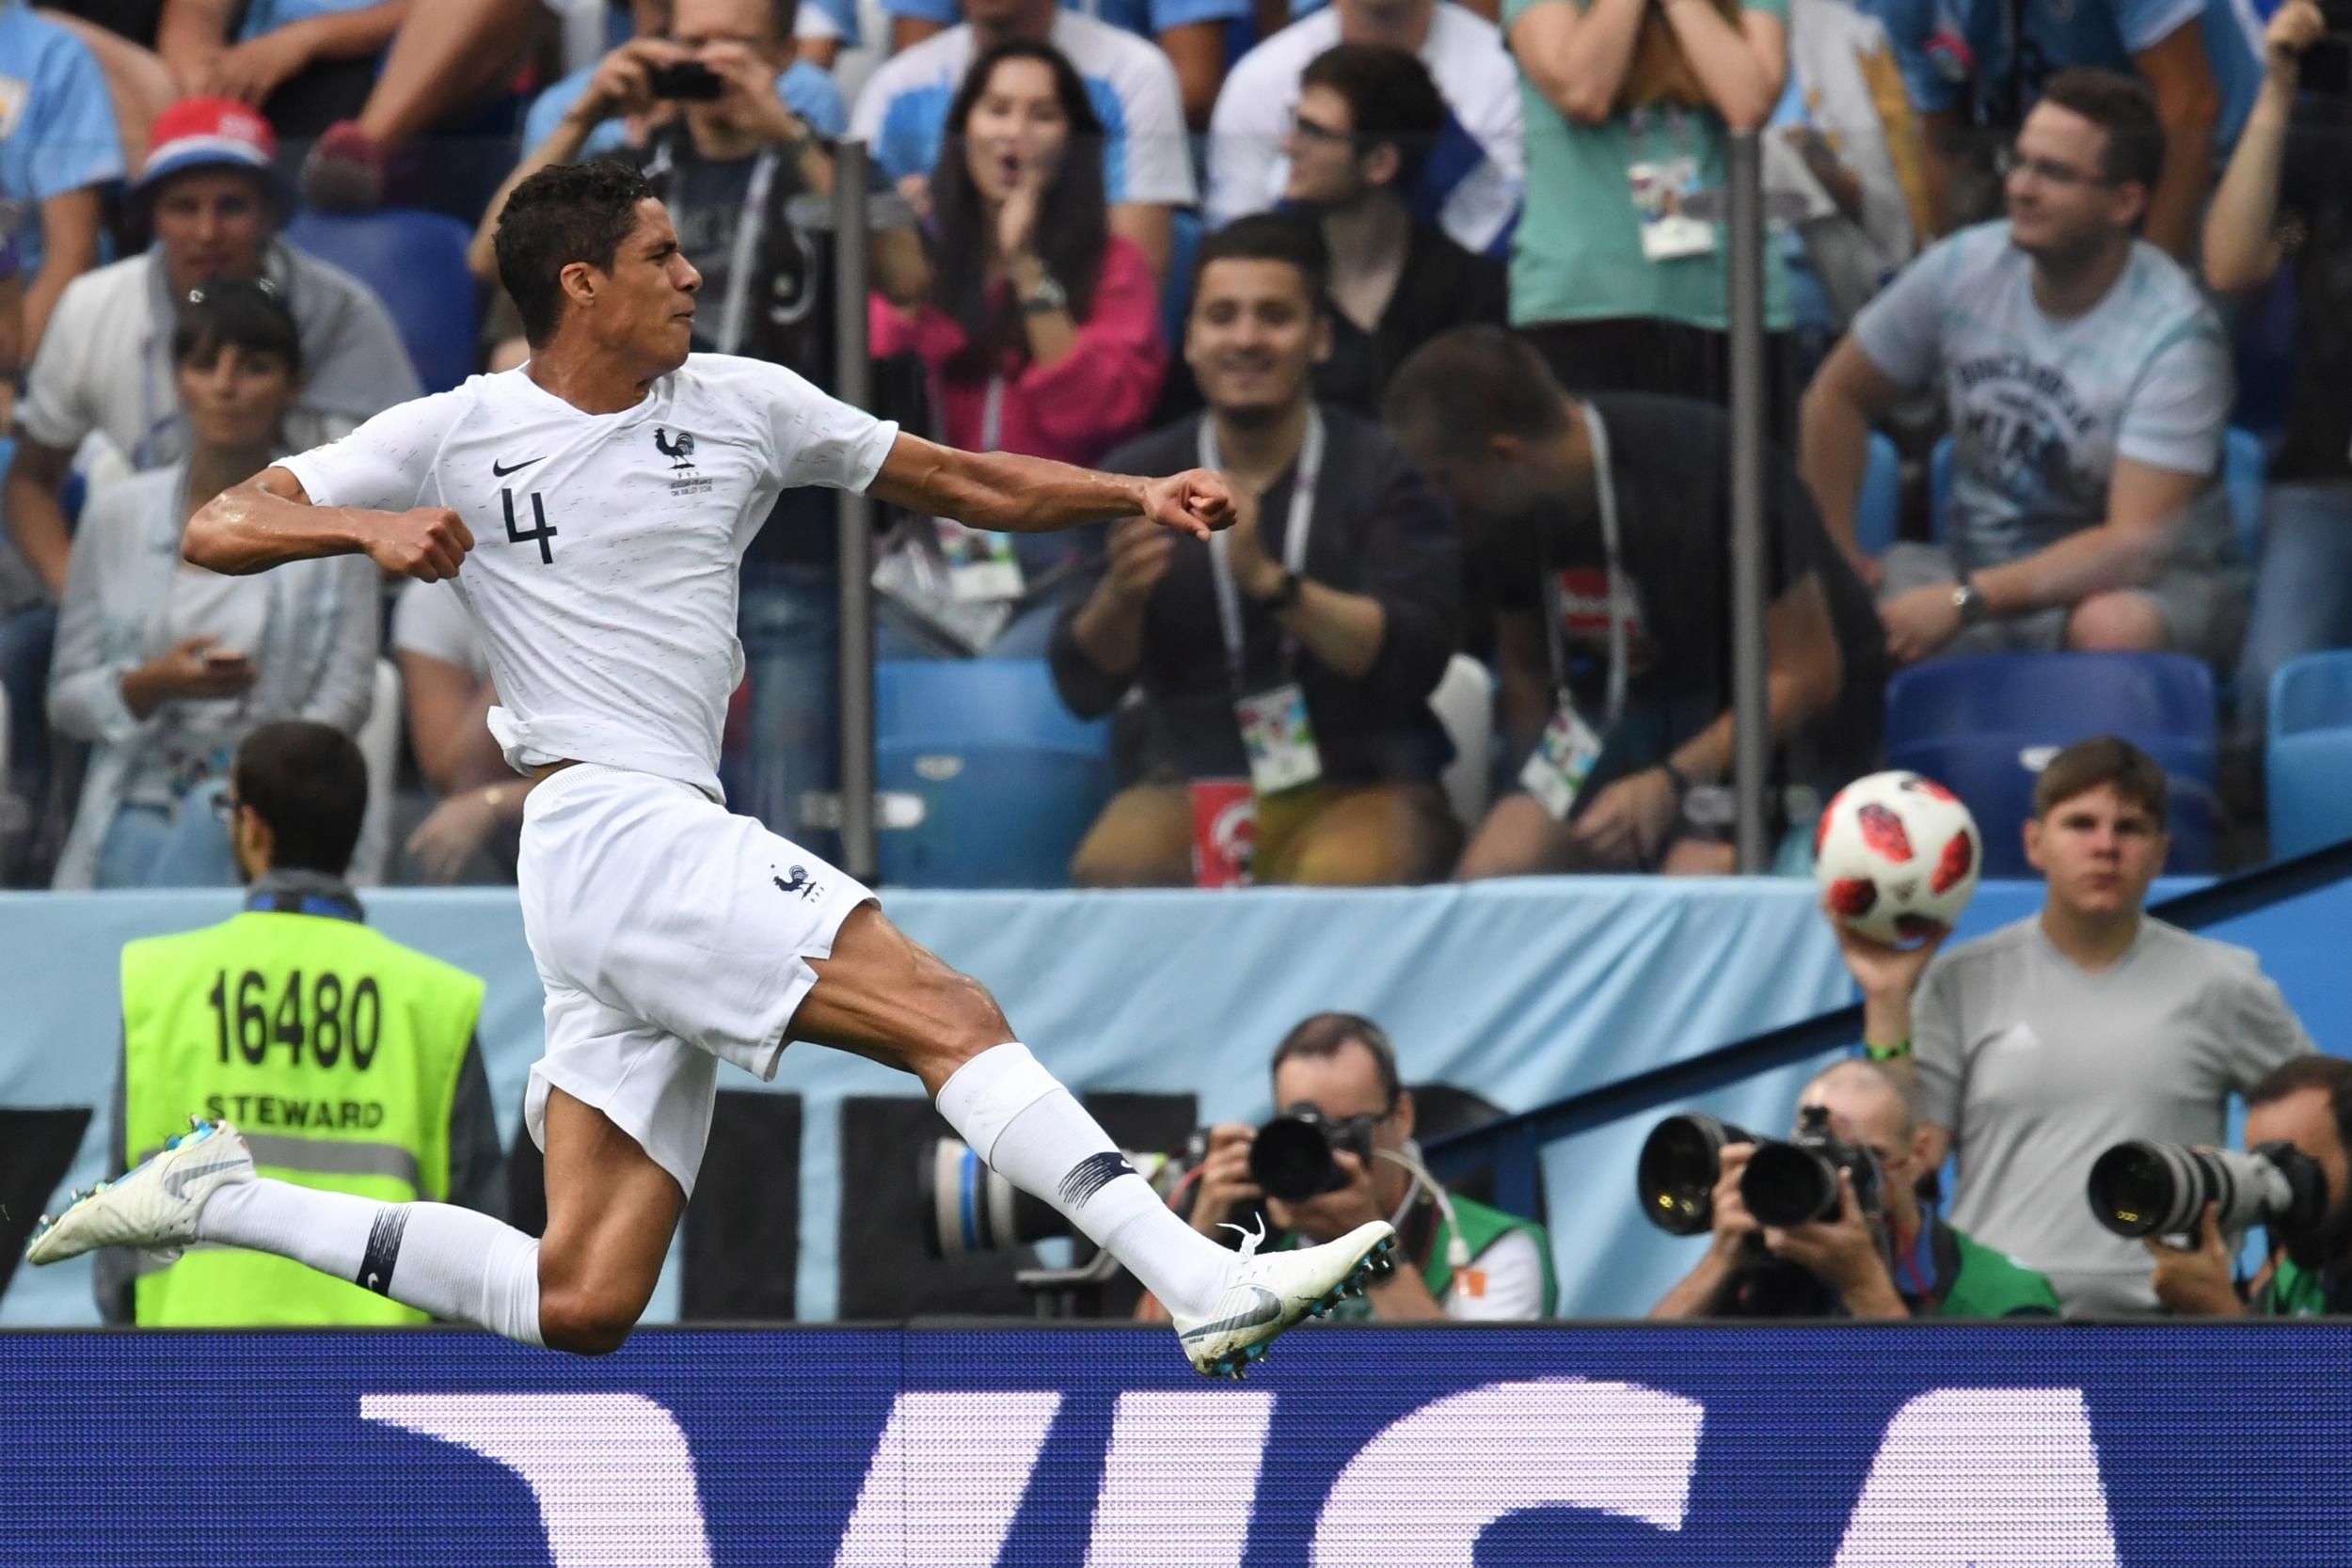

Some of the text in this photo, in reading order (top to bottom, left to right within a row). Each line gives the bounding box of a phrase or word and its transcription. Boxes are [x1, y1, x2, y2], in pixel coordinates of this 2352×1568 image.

[501, 487, 558, 565] 4
[210, 970, 380, 1070] 16480
[206, 1095, 384, 1128] STEWARD
